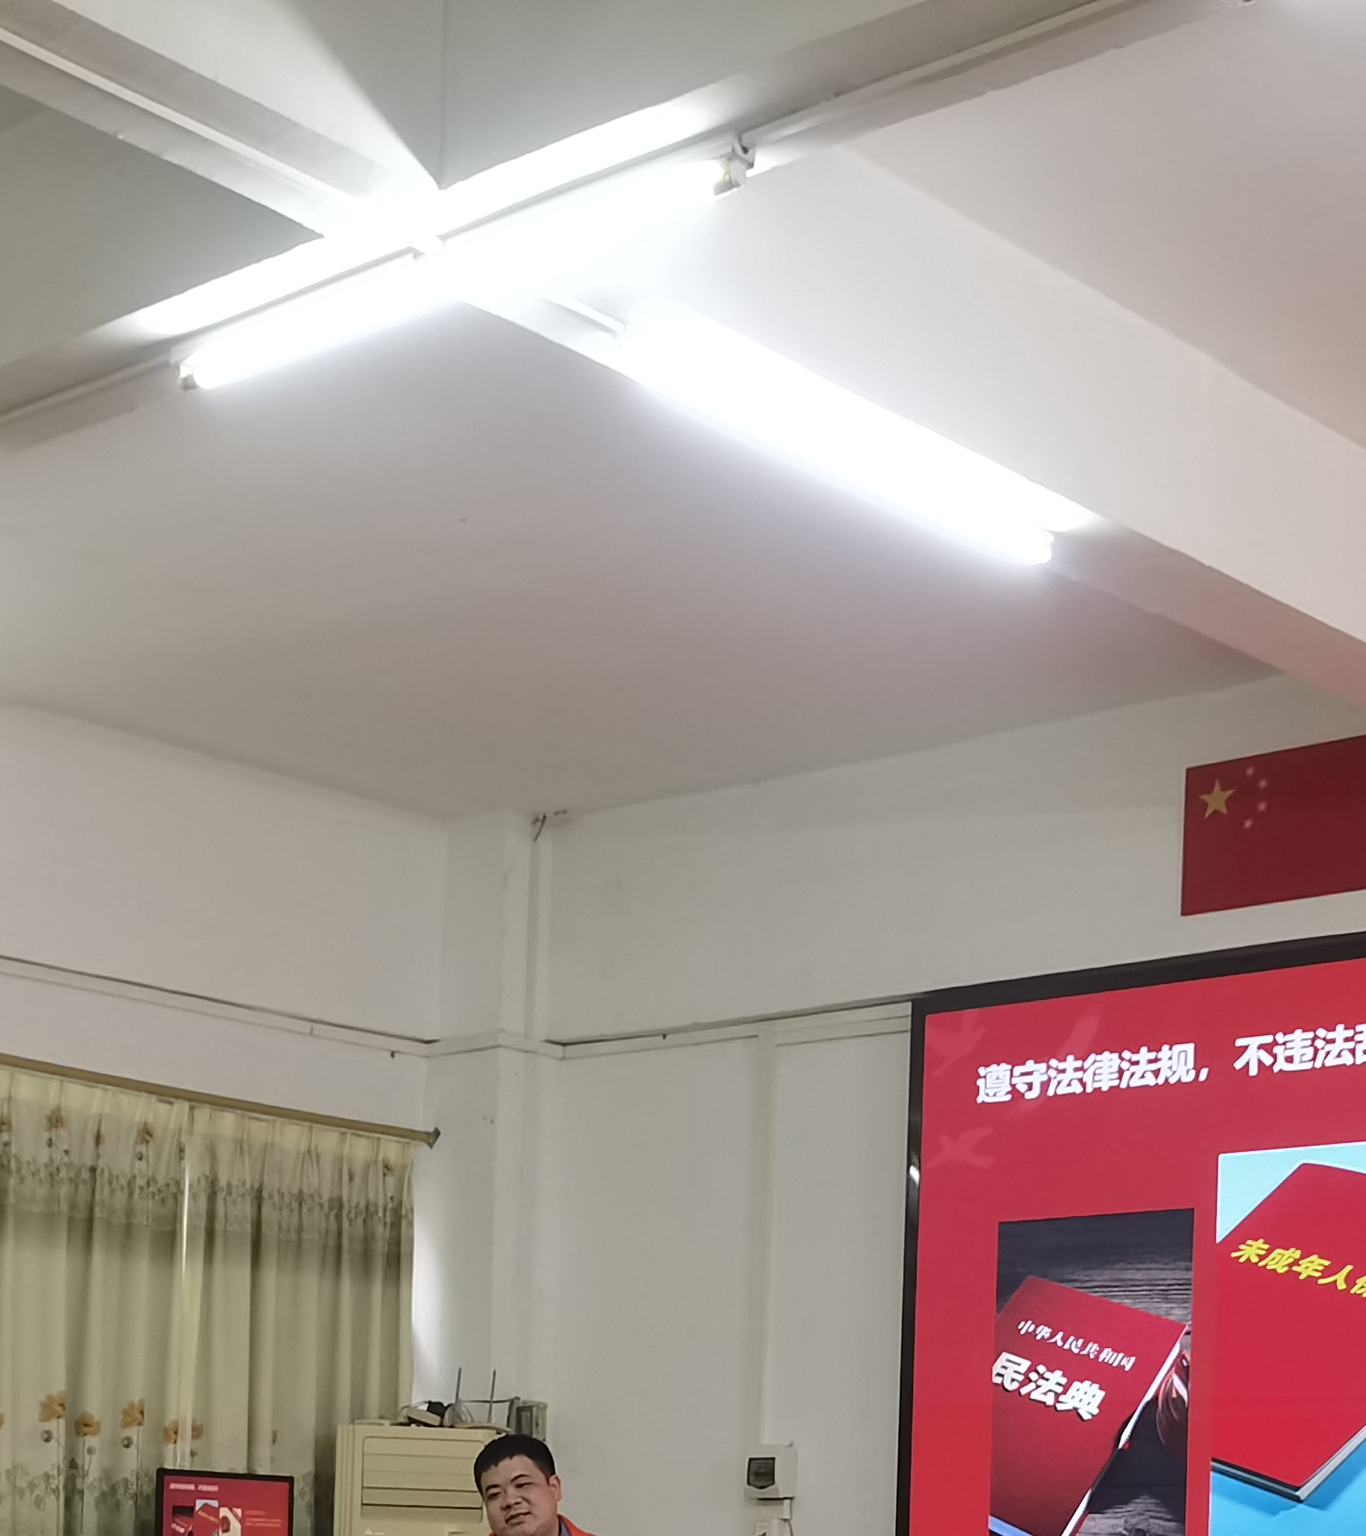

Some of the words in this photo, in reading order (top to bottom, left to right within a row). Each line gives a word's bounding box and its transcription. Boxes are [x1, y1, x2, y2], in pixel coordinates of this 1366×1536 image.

[1017, 1320, 1137, 1372] 中华人民共和国
[992, 1352, 1106, 1421] 民法典
